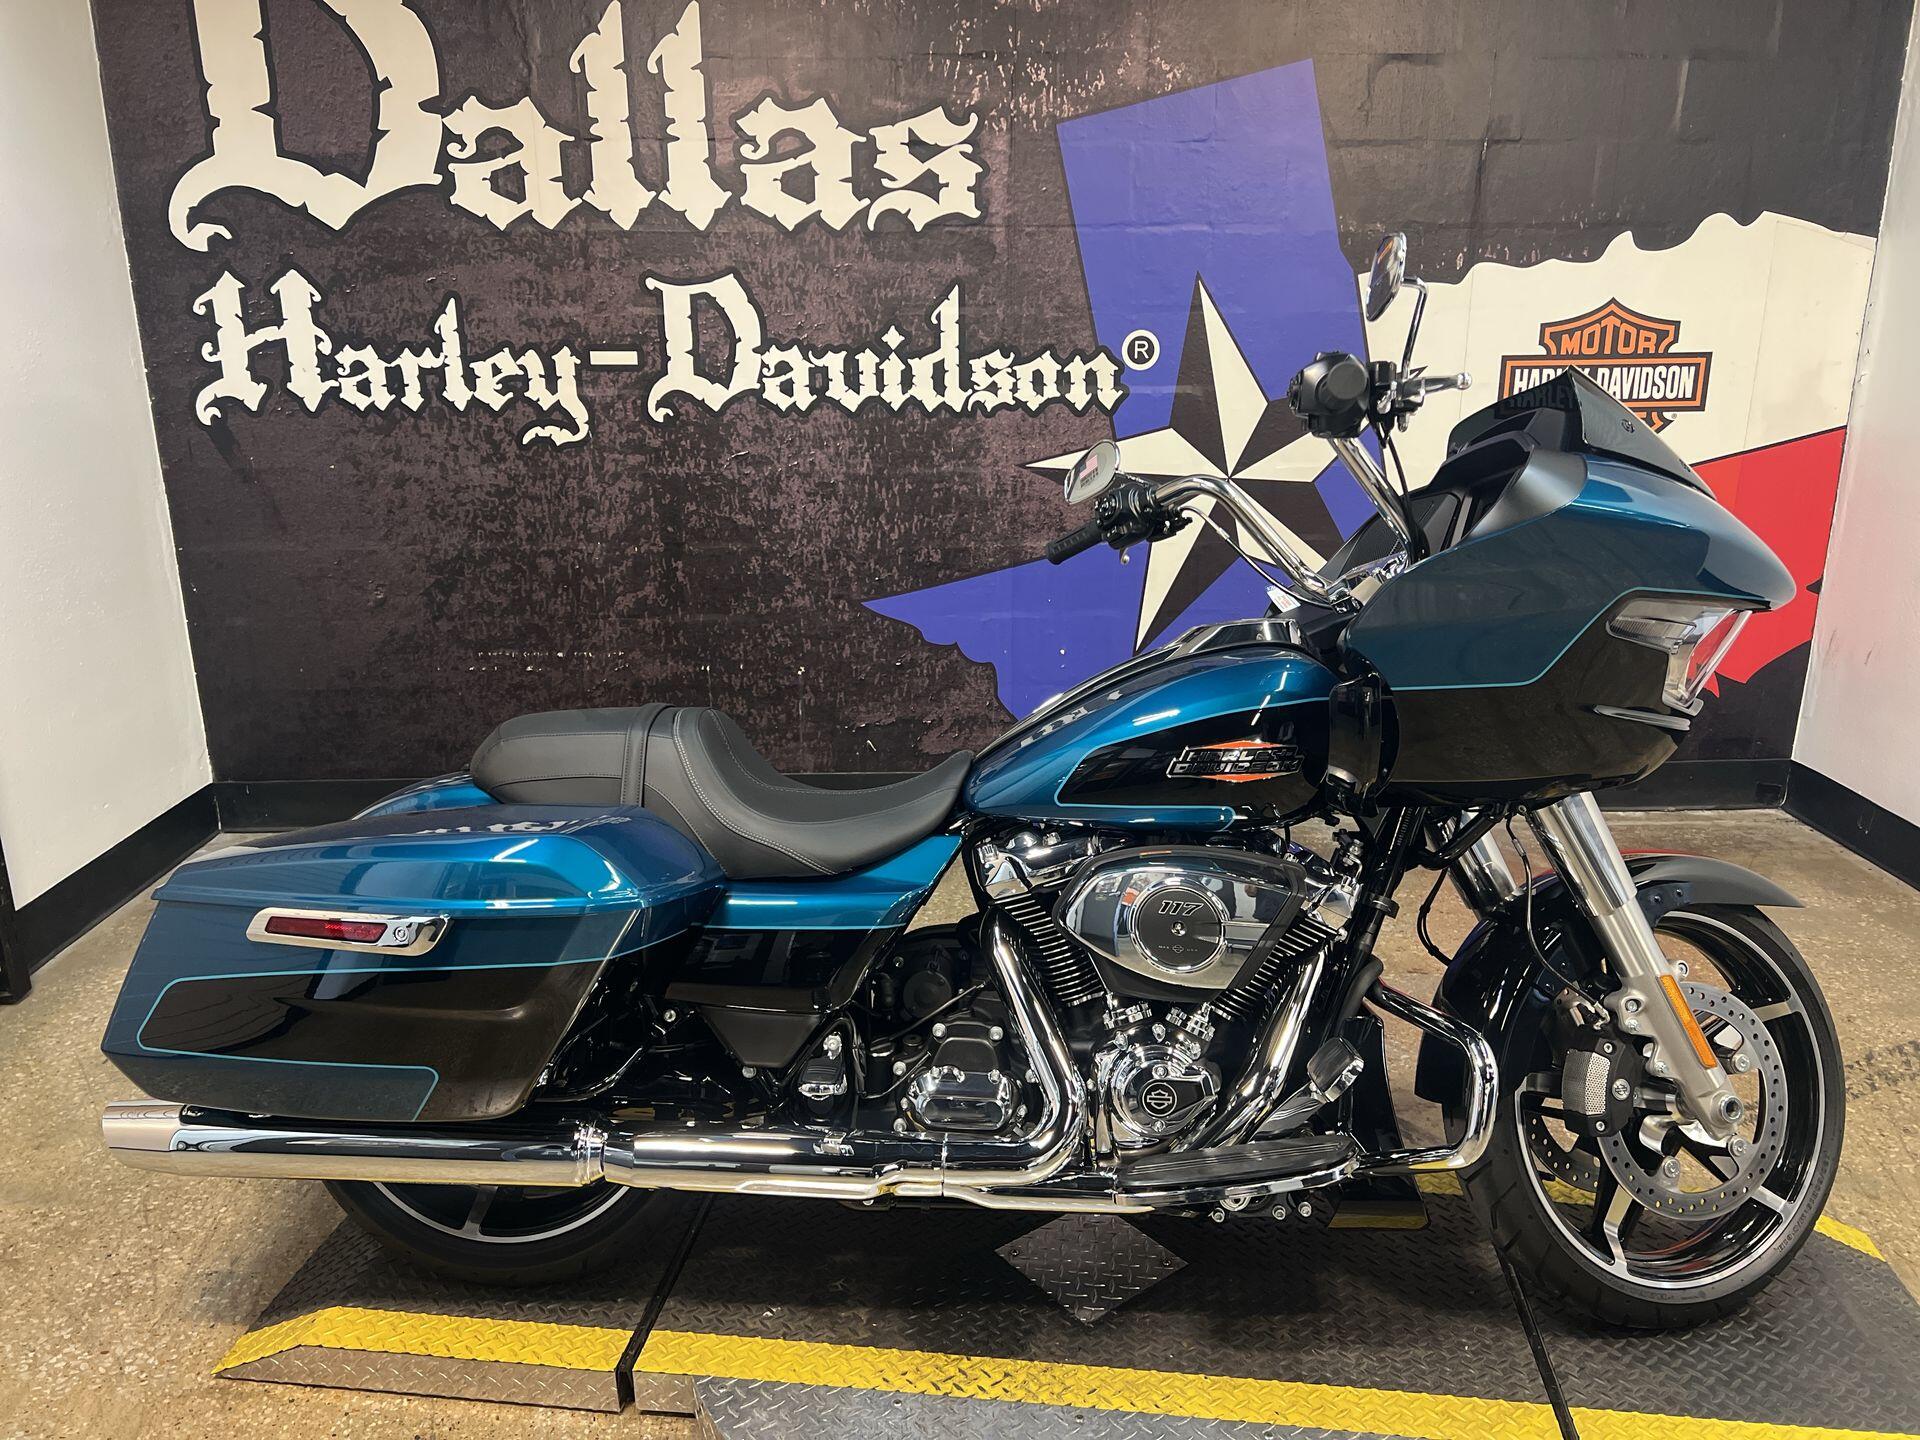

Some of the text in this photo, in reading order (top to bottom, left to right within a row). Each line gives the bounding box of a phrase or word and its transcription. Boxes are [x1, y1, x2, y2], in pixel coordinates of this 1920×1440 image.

[169, 0, 981, 252] Dallas
[1560, 315, 1657, 355] MOTOR
[192, 267, 1124, 446] Harley-Davidson
[1173, 760, 1300, 774] DAVIDSON
[1158, 900, 1204, 916] 117
